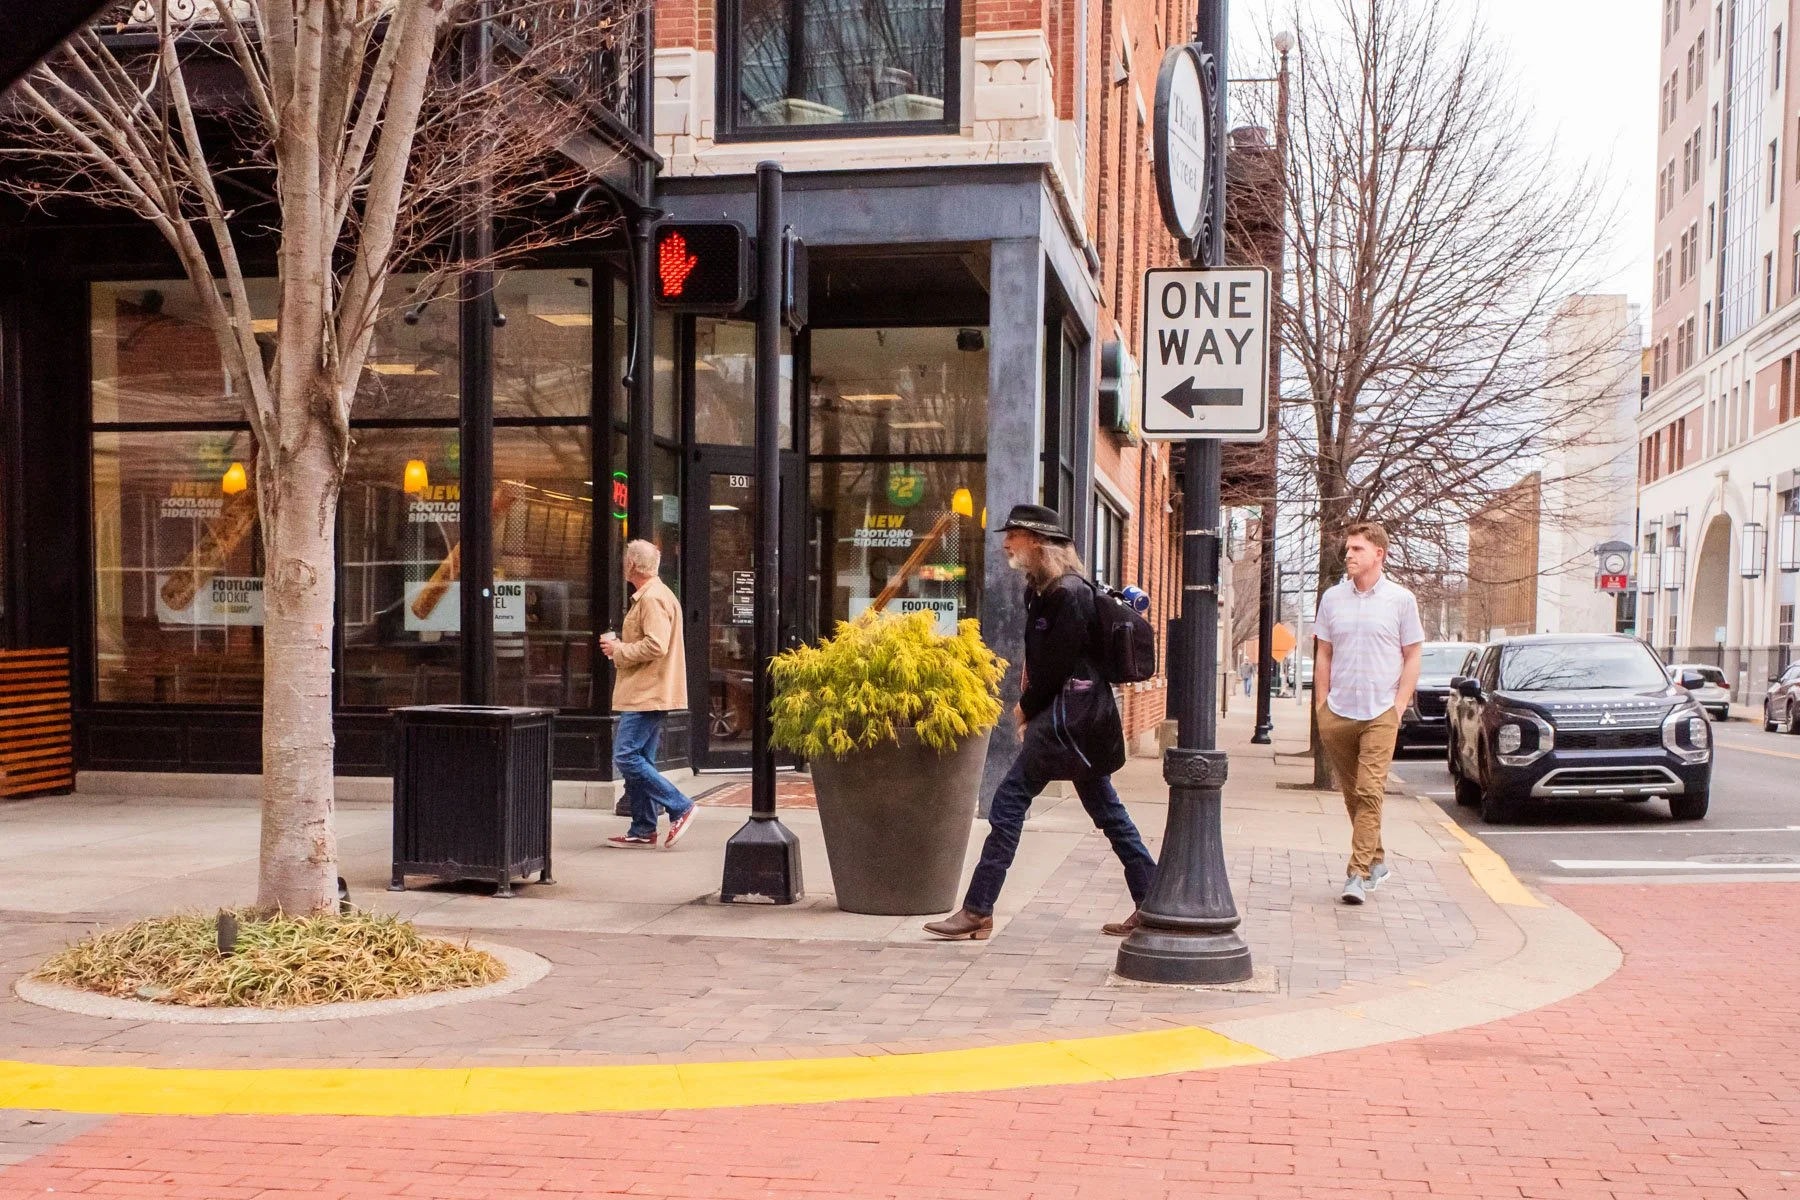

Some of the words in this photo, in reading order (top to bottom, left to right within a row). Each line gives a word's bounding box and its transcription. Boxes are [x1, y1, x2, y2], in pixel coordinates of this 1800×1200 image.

[1173, 92, 1197, 142] Third
[1170, 142, 1197, 192] Street
[1161, 281, 1252, 319] ONE
[1158, 328, 1254, 365] WAY
[731, 475, 748, 487] 301
[161, 497, 223, 508] FOOTLONG
[409, 501, 460, 512] FOOTLO
[160, 508, 222, 518] SIDEKICKS
[408, 512, 460, 523] SIDEKIC
[866, 515, 904, 528] NEW
[855, 529, 913, 538] FOOTLONG
[853, 538, 912, 547] SIDEKICKS
[492, 585, 521, 596] LONG
[212, 591, 250, 603] COOKIE
[902, 601, 954, 611] FOOTLONG
